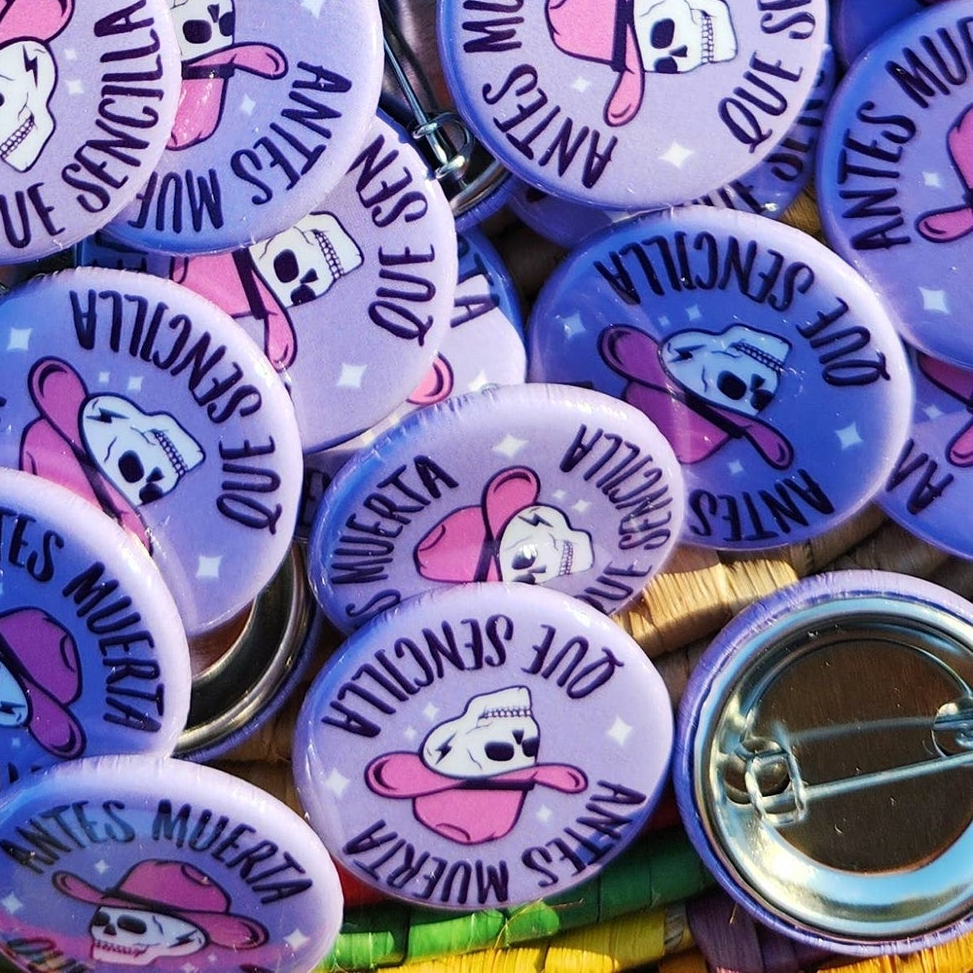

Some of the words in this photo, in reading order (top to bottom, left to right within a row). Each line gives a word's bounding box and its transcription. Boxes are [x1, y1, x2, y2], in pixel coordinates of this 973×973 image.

[230, 61, 353, 206] ANTES
[481, 64, 619, 189] ANTES
[718, 51, 802, 154] QUE
[127, 168, 224, 234] MUE
[836, 100, 917, 251] ANTES
[367, 244, 437, 347] QUE
[593, 231, 816, 312] SENCILLA
[69, 288, 263, 426] SENCILLA
[795, 296, 891, 387] QUE
[215, 435, 282, 535] QUE
[331, 454, 459, 585] MUERTA
[559, 424, 673, 552] SENCILLA
[688, 468, 835, 543] ANTES
[62, 561, 167, 734] MUERTA
[321, 613, 515, 739] SENCILLA
[521, 624, 626, 700] QUE
[151, 798, 313, 905] MUERTA
[341, 819, 510, 904] MUERTA
[521, 779, 648, 889] ANTES
